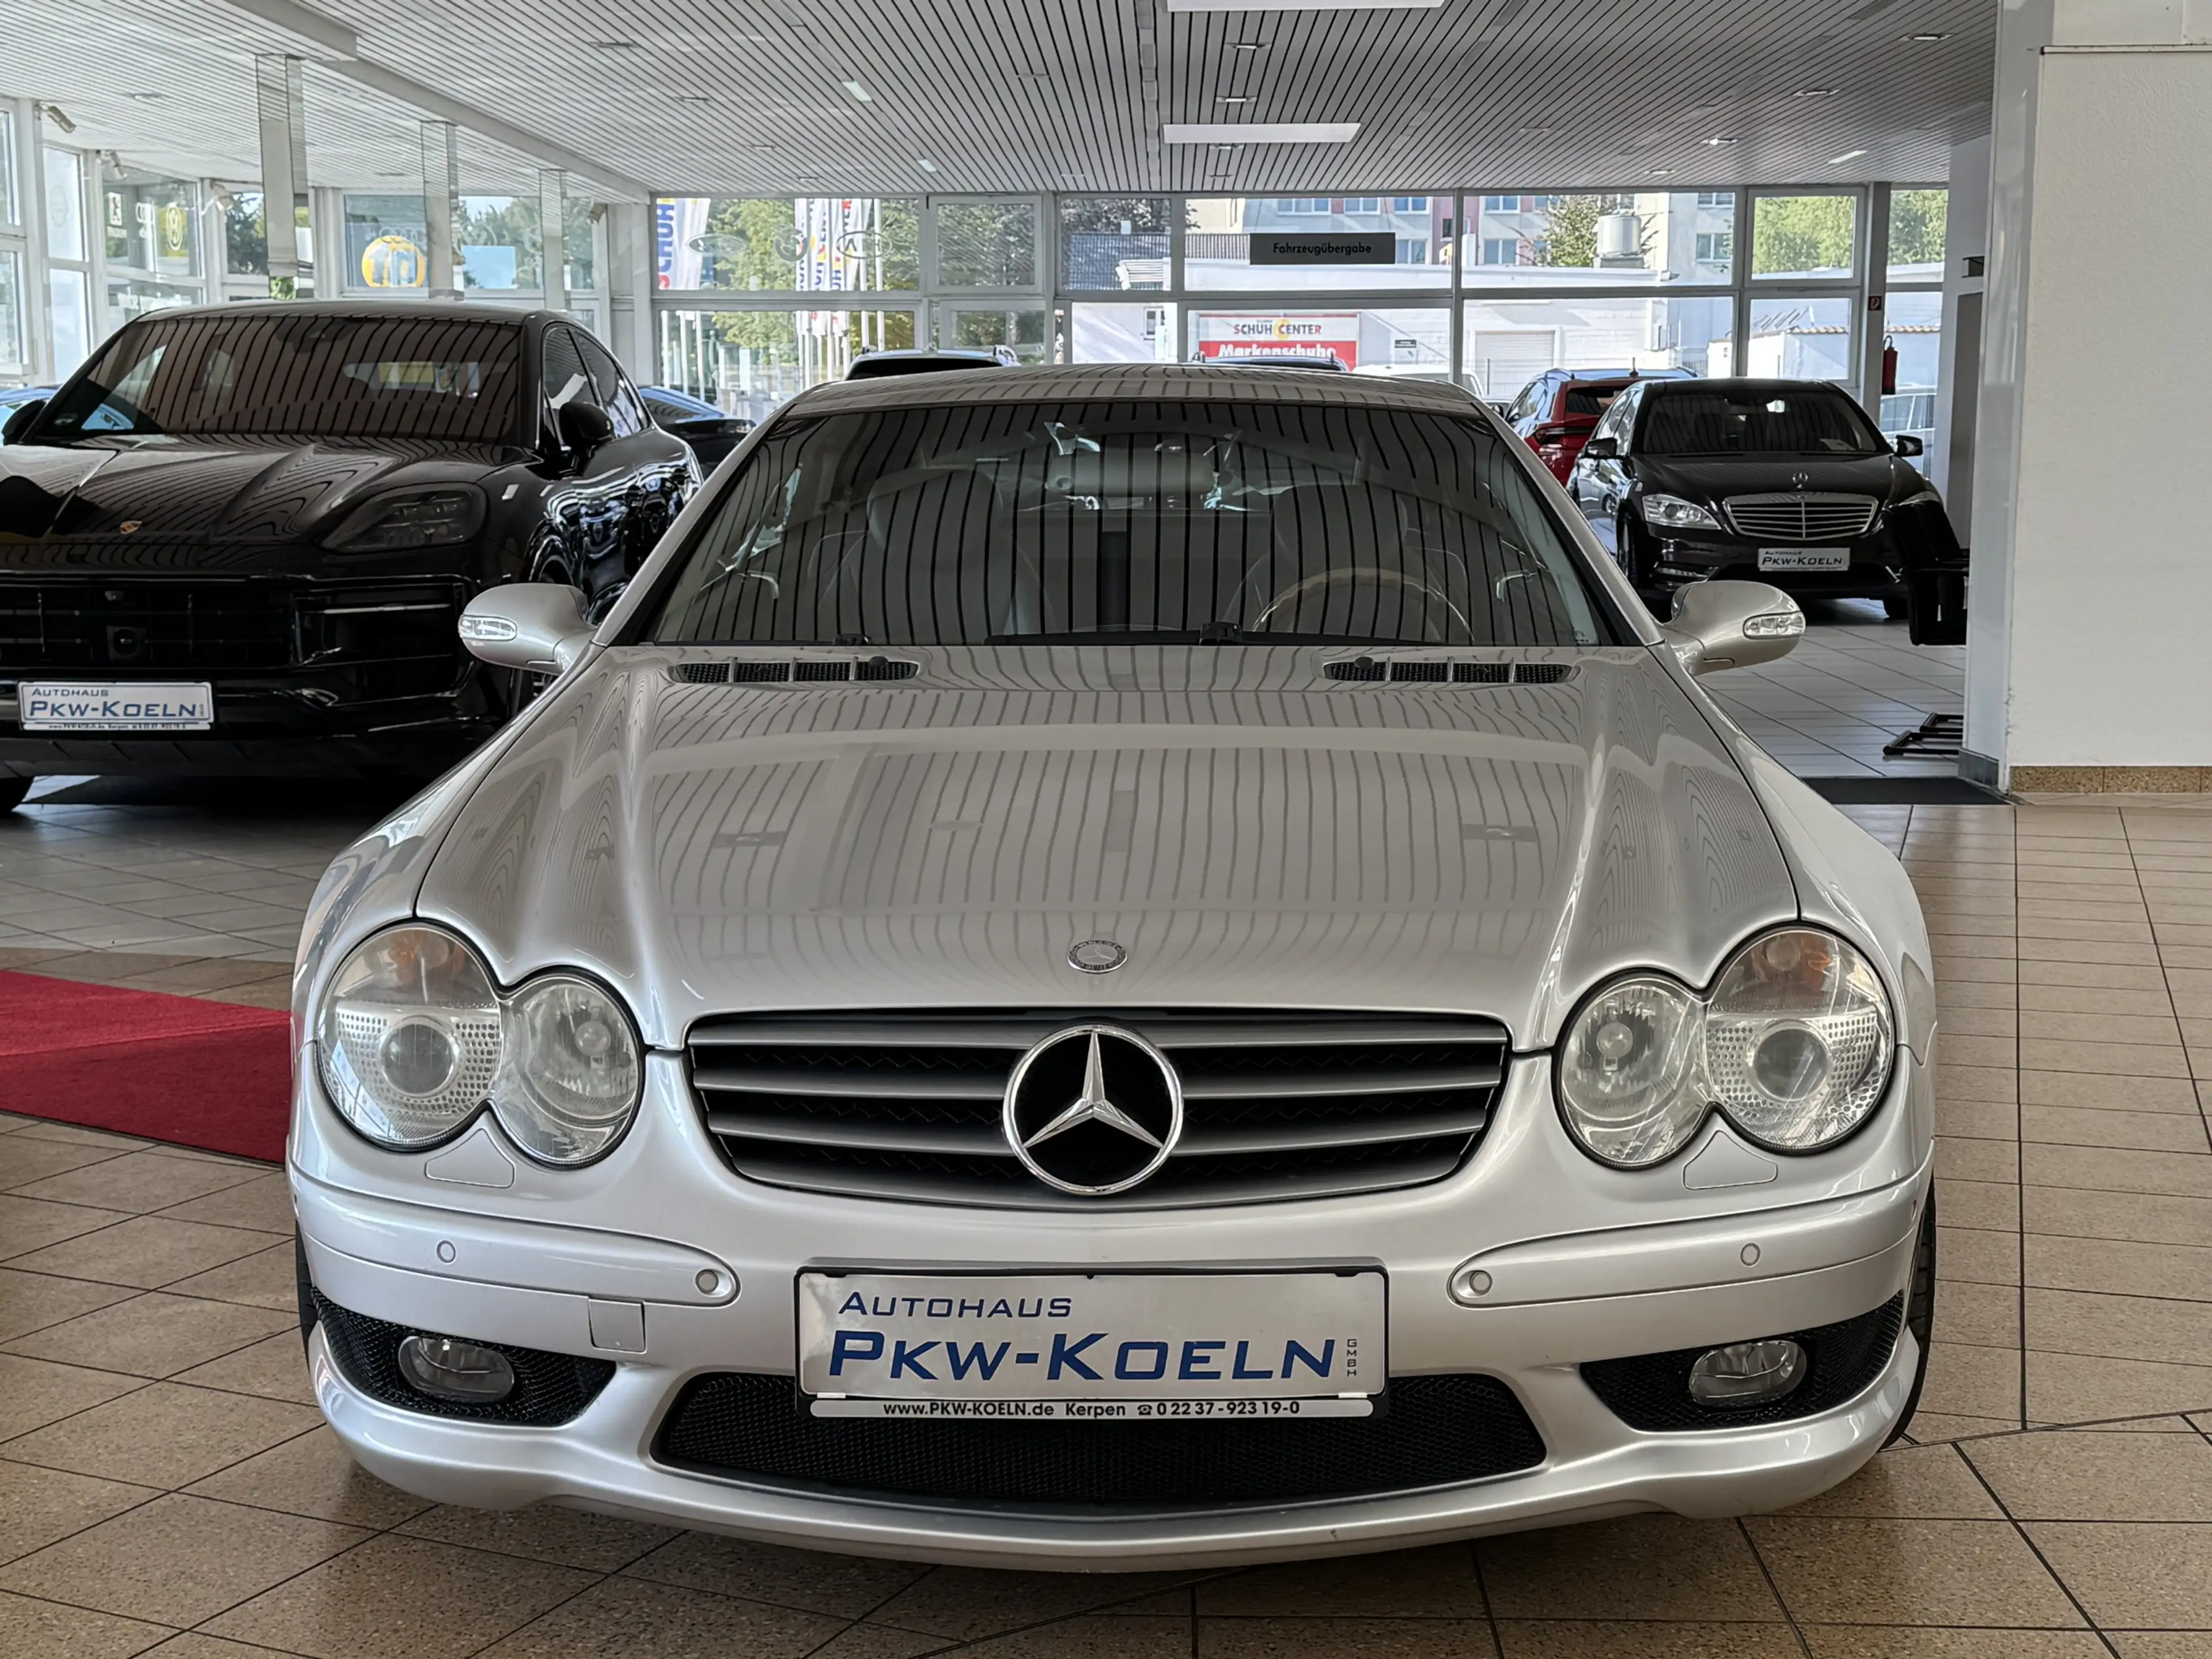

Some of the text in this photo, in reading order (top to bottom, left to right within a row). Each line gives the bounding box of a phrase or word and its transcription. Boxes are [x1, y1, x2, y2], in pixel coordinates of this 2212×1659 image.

[1273, 242, 1372, 256] Fahrzeugübergabe
[1234, 324, 1322, 335] SCHUH CENTER
[1762, 556, 1842, 565] PKW-KOELN
[31, 688, 109, 696] AUTOHAUS
[30, 700, 196, 717] PKW-KOELN
[838, 1291, 1072, 1318] AUTOHAUS
[828, 1330, 1335, 1381] PKW-KOELN
[1346, 1338, 1357, 1377] GMBH
[883, 1403, 1054, 1416] www.PKW-KOELN.de
[1066, 1403, 1126, 1418] Kerpen
